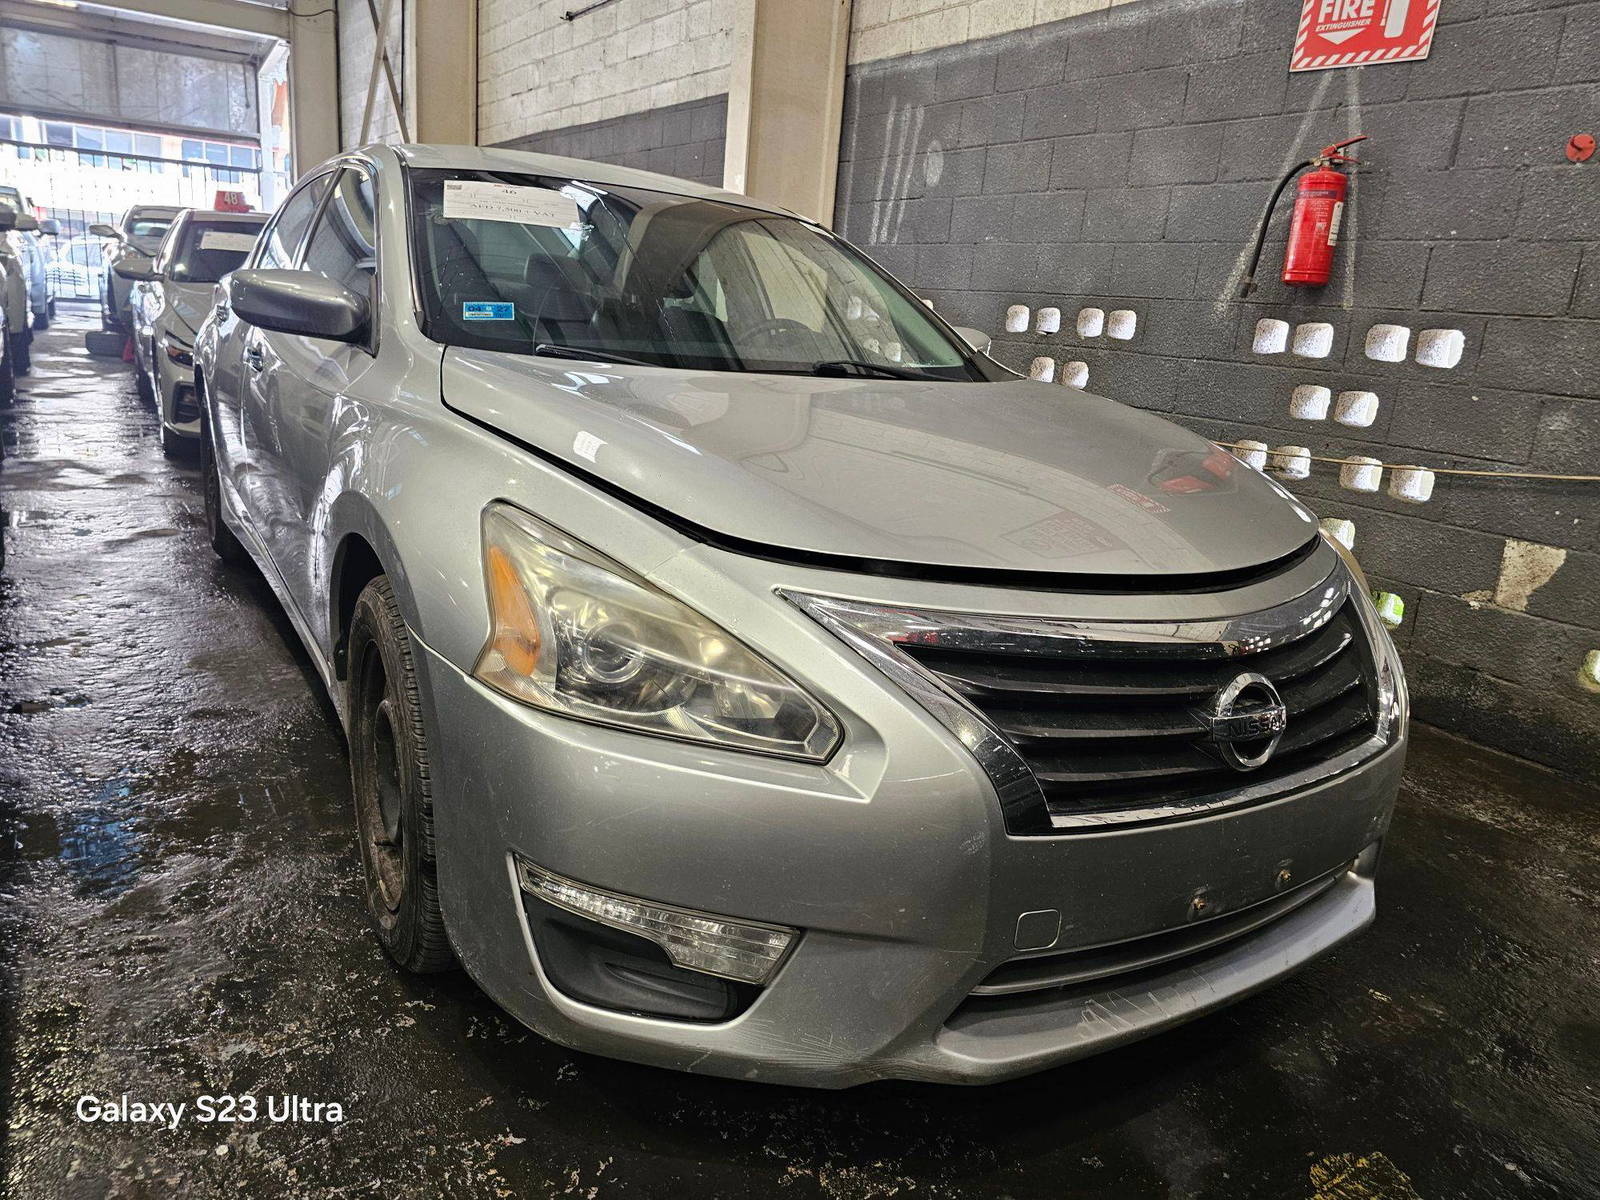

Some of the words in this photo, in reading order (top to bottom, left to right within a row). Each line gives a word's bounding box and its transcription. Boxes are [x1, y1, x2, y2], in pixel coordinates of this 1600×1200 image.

[1318, 0, 1375, 23] FIRE
[1315, 18, 1372, 32] EXTINGUISHER
[224, 192, 238, 205] 48
